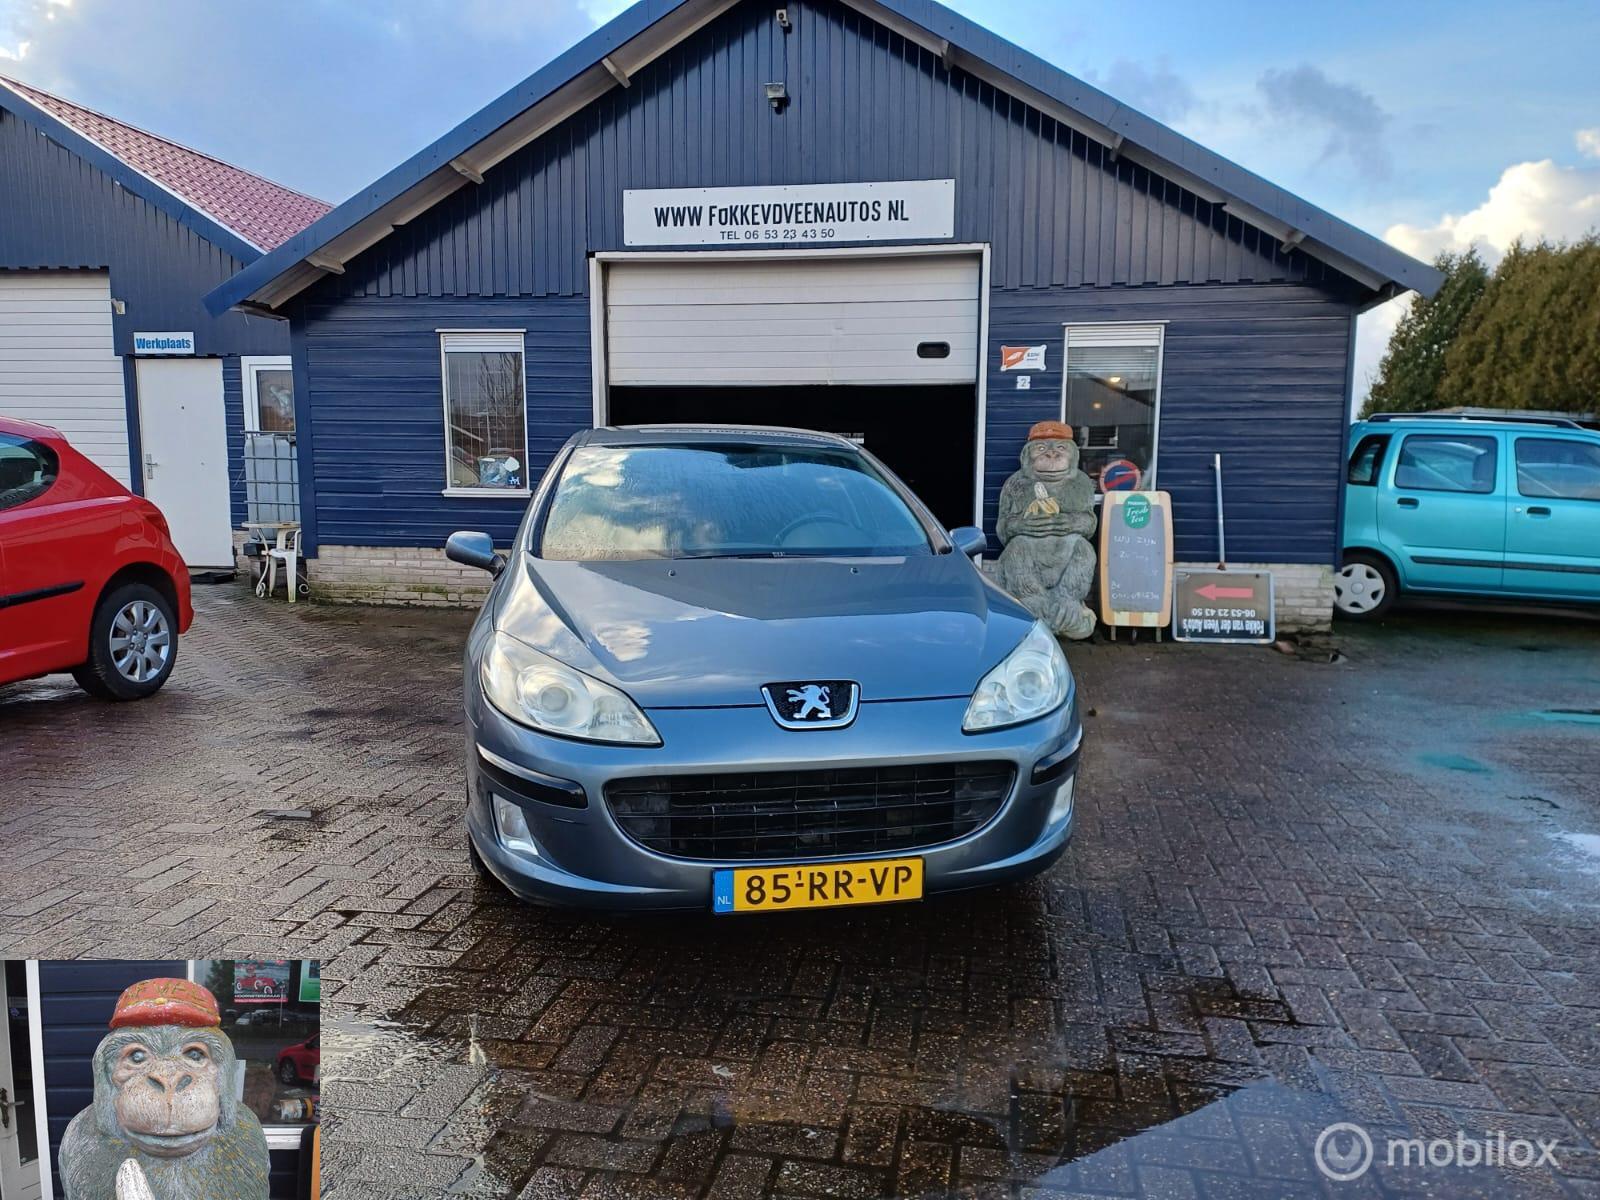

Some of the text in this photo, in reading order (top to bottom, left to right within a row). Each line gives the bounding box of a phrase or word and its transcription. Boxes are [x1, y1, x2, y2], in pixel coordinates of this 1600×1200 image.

[654, 205, 703, 228] WWW
[888, 199, 909, 221] NL
[719, 228, 835, 240] TEL 06 53 23 43 50
[136, 338, 192, 350] Werkplaats
[1192, 608, 1203, 616] 50
[717, 895, 732, 905] NL
